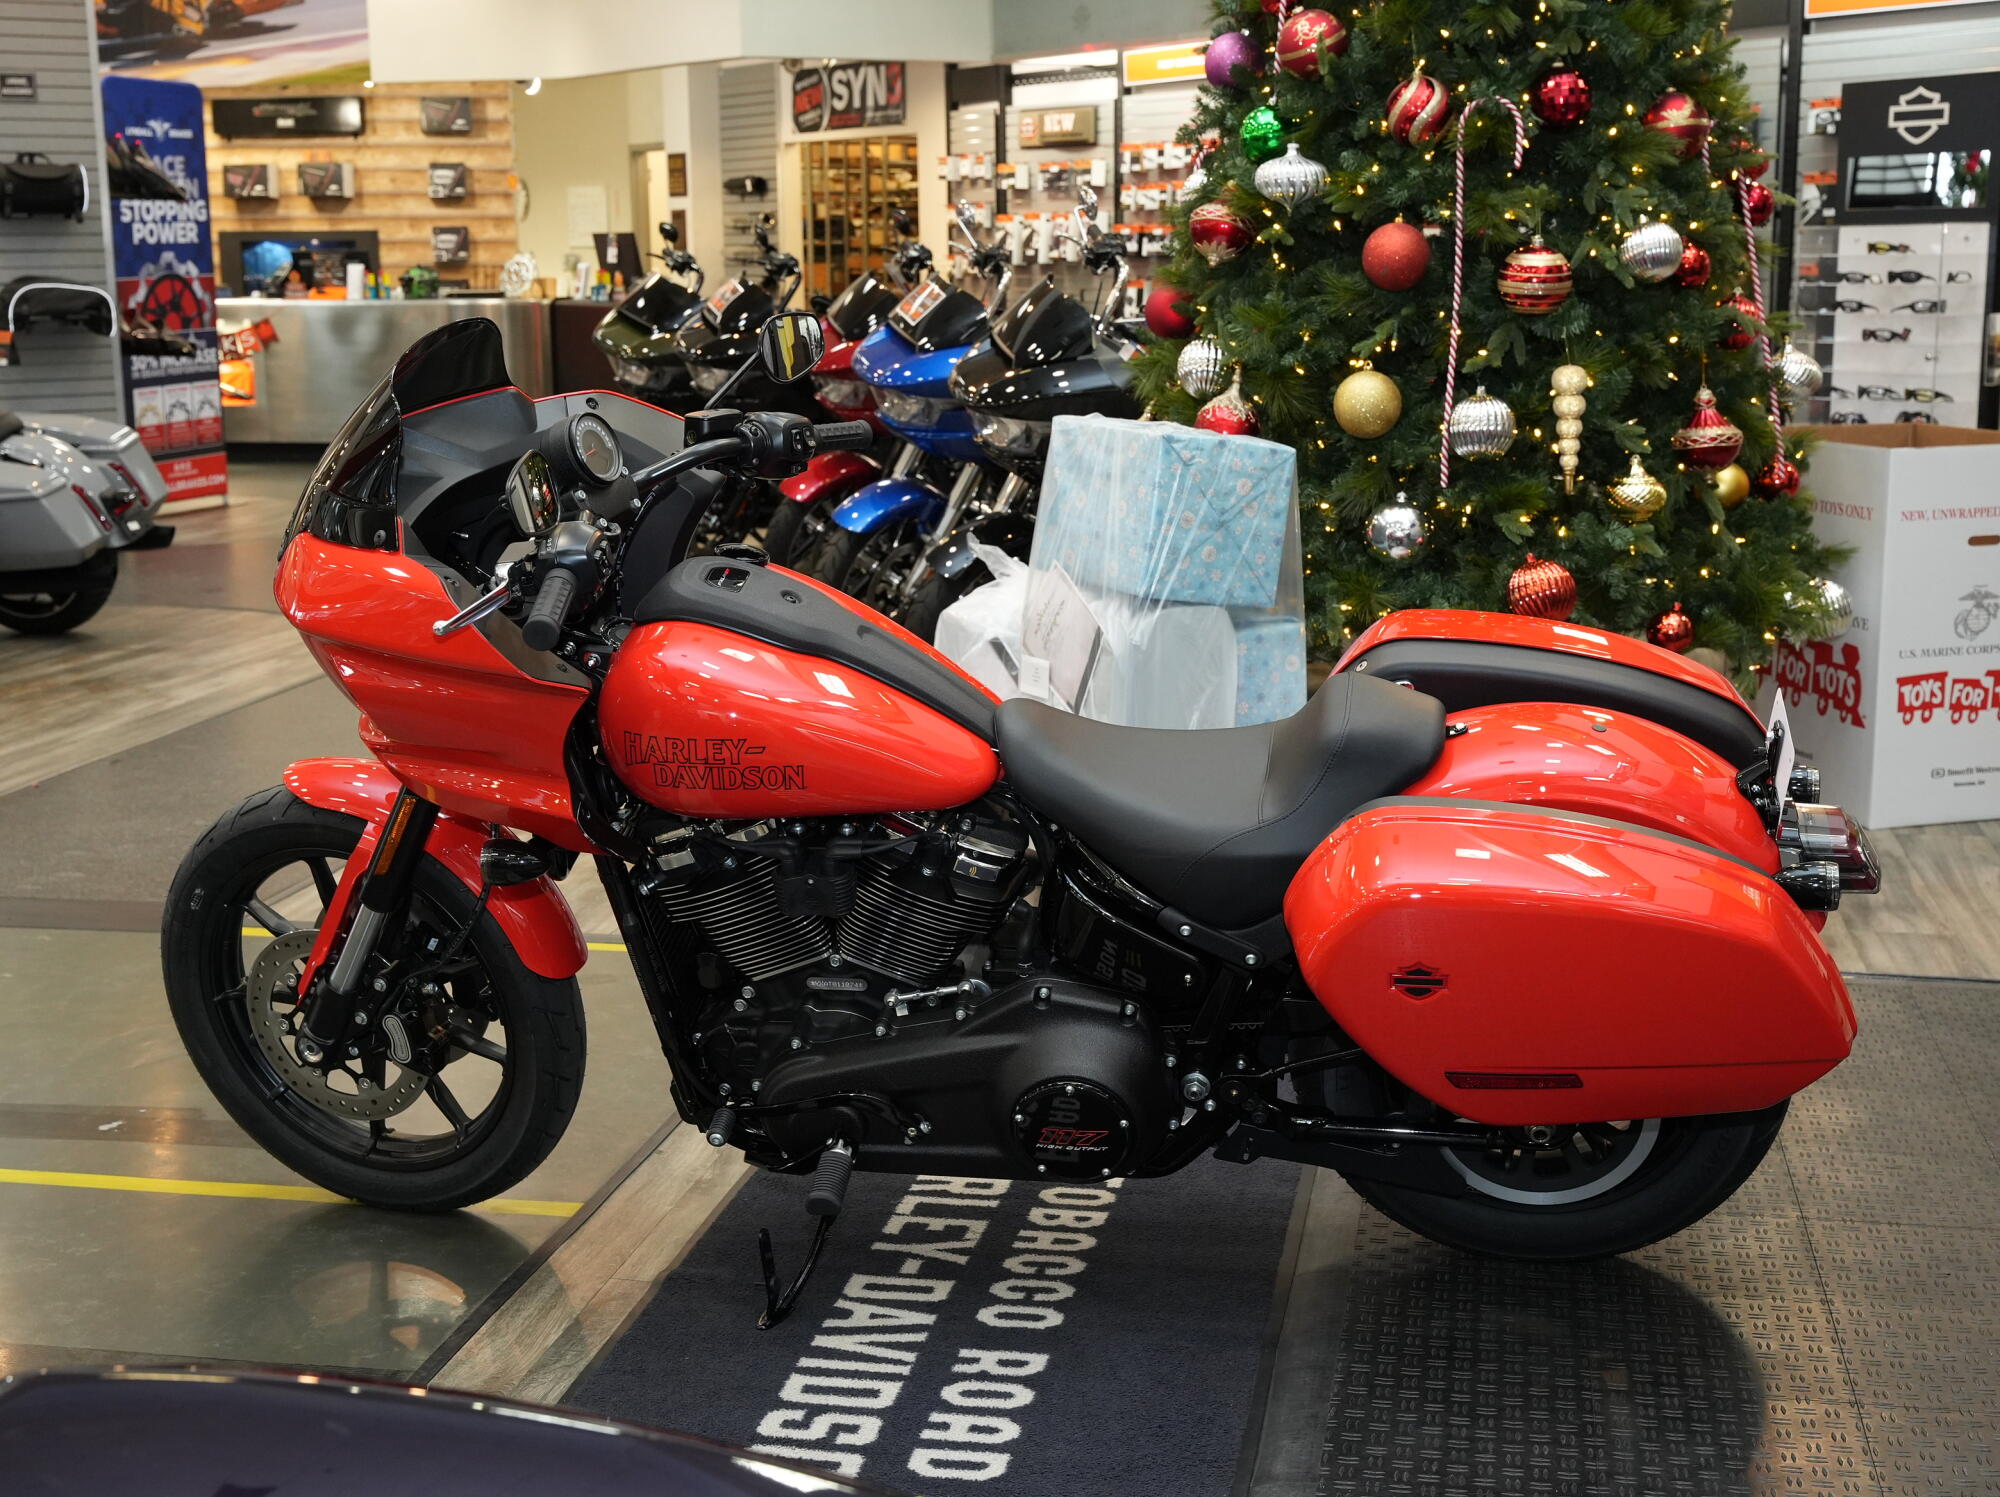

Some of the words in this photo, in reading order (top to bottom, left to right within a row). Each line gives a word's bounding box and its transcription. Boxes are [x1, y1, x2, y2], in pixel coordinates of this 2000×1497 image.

[119, 199, 208, 224] STOPPING
[132, 221, 199, 245] POWER
[1819, 500, 1844, 515] TOYS
[1845, 504, 1873, 521] ONLY
[1932, 505, 2000, 520] UNWRAPPED
[1920, 645, 1964, 658] MARINE
[1778, 650, 1806, 687] FOR
[1815, 663, 1856, 707] TOTS
[1900, 679, 1942, 707] TOYS
[1951, 682, 1985, 707] FOR
[624, 730, 767, 766] HARLEY-
[653, 763, 808, 790] DAVIDSON
[1039, 1127, 1109, 1146] 117
[976, 1177, 1125, 1330] OBACCO
[747, 1175, 1014, 1477] RLEY-DAVIDS
[907, 1348, 1050, 1481] ROAD
